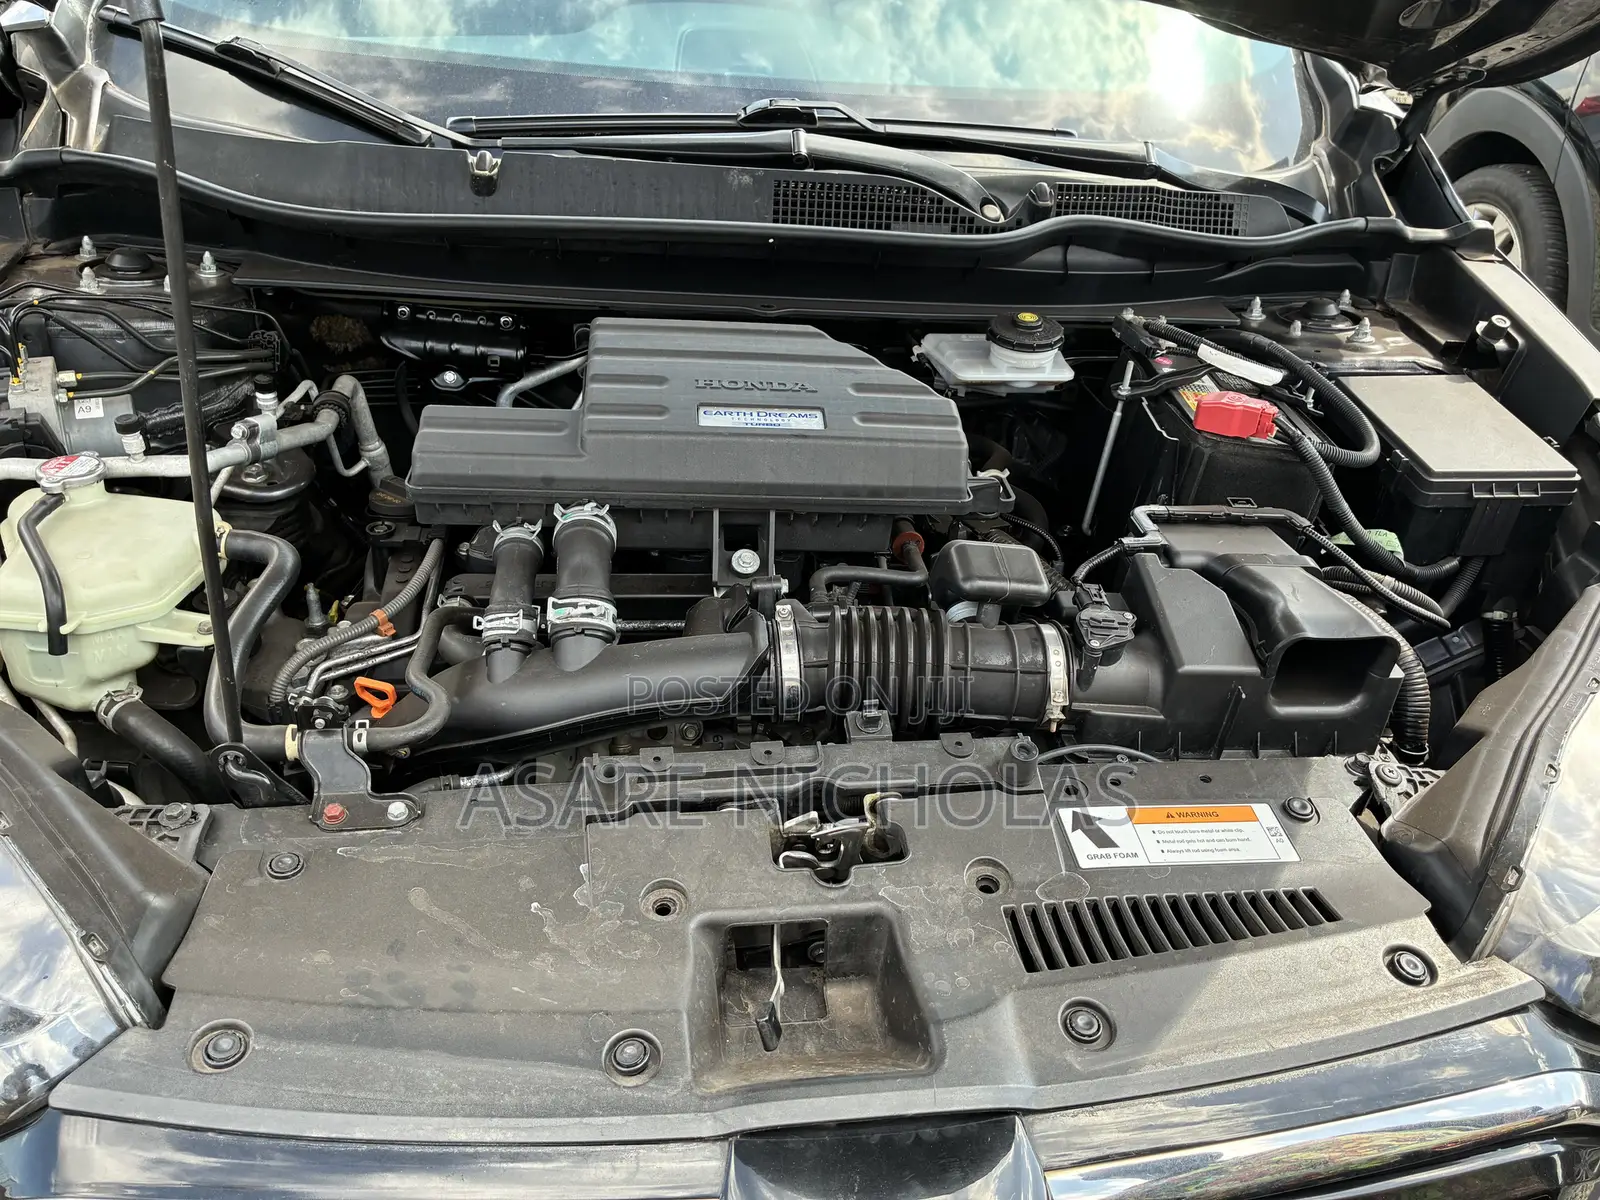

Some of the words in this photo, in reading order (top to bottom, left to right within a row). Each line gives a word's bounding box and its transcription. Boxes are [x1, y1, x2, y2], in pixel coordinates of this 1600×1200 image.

[694, 379, 818, 393] HONDA
[78, 405, 92, 413] A9
[756, 410, 818, 419] DREAMS
[1175, 811, 1220, 819] WARNING
[1086, 852, 1112, 861] GRAB
[1113, 852, 1139, 860] FOAM
